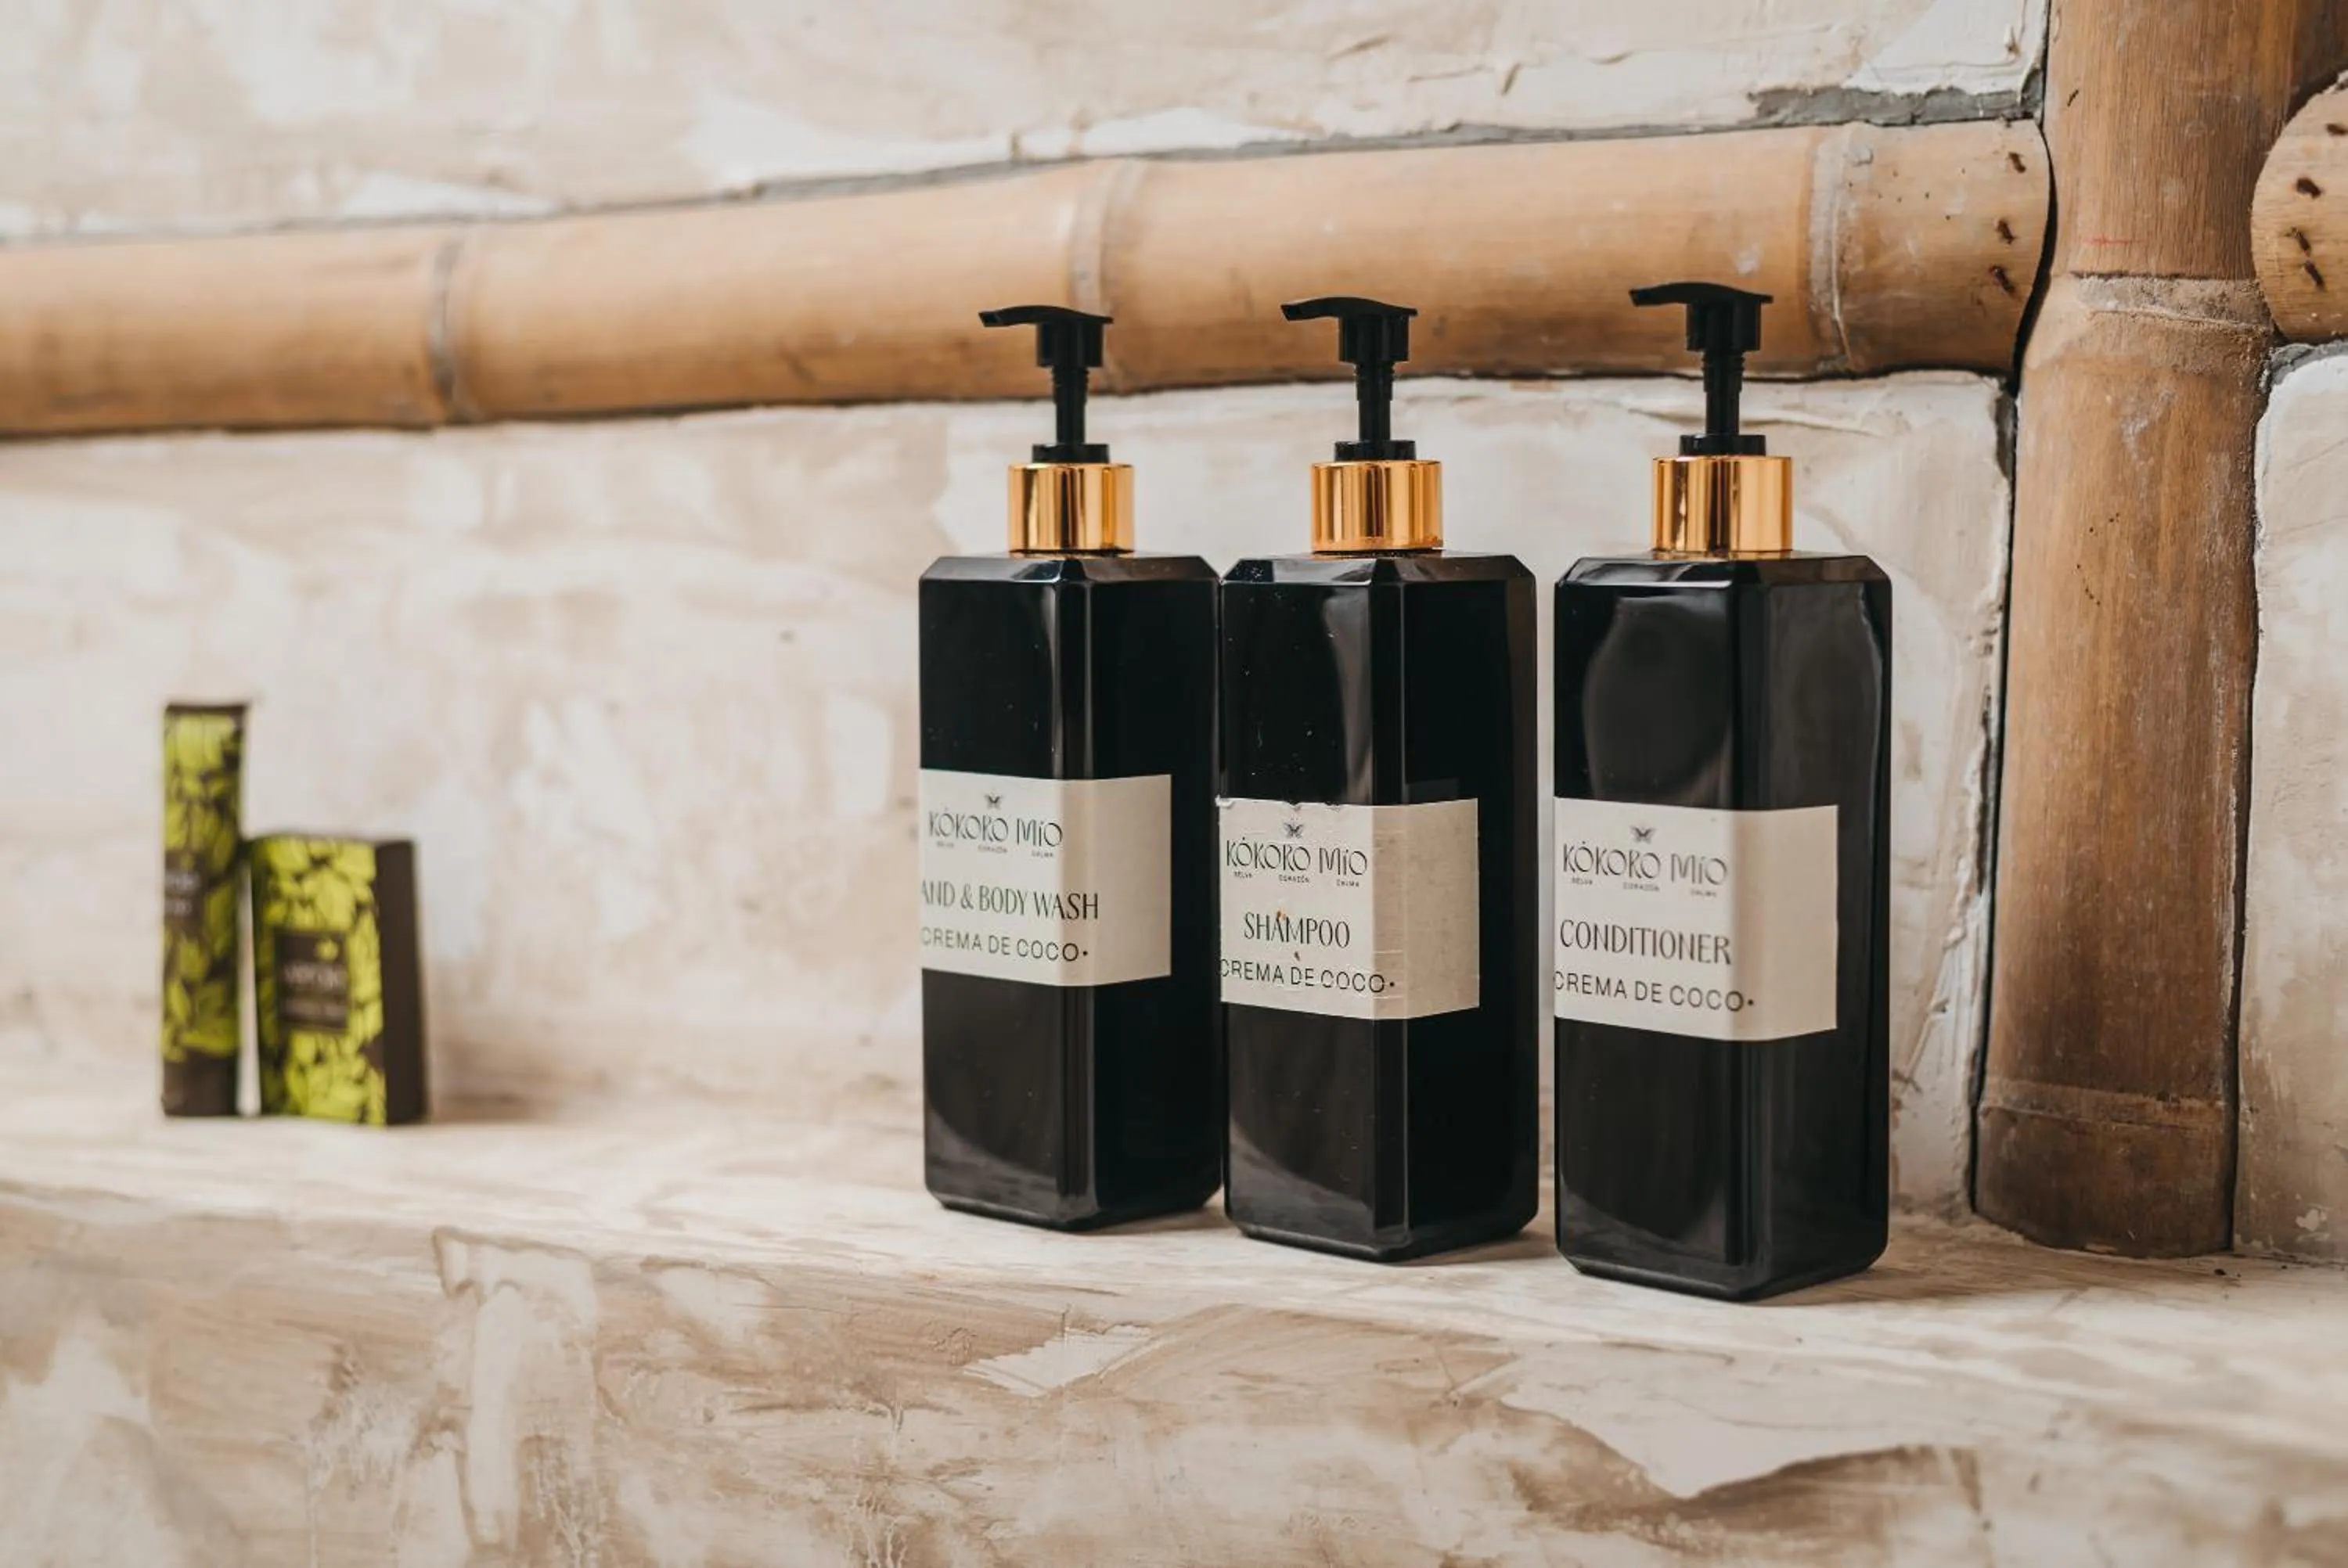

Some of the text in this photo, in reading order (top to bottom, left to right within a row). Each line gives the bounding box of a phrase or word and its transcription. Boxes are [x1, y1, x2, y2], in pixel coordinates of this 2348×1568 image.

[960, 883, 974, 910] &
[978, 885, 1026, 915] BODY
[1034, 892, 1098, 920] WASH
[921, 926, 983, 951] CREMA
[988, 935, 1011, 955] DE
[1244, 912, 1350, 949] SHAMPOO
[1560, 919, 1731, 966] CONDITIONER
[1291, 966, 1315, 987] DE
[1634, 980, 1662, 1003] DE
